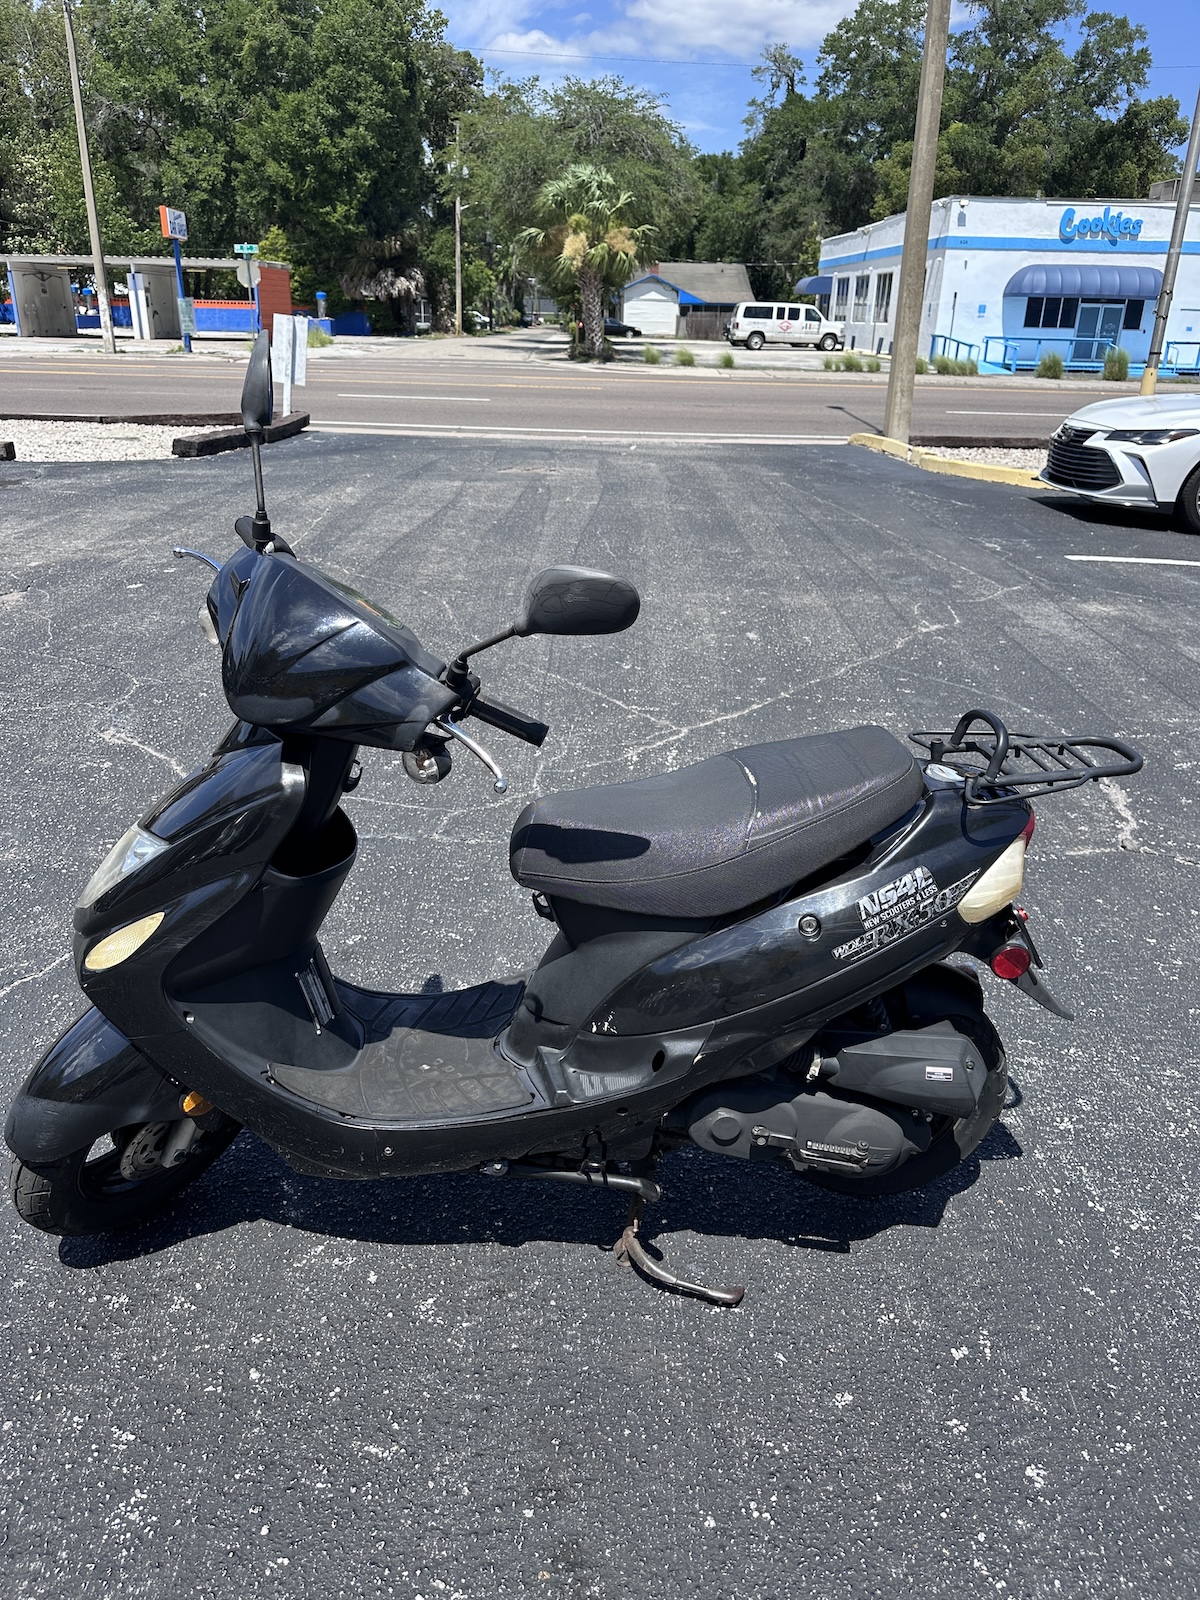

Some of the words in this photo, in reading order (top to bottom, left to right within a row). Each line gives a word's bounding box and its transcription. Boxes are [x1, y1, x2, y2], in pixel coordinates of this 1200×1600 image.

[1060, 206, 1143, 238] Cookies
[858, 867, 933, 920] NS4L
[864, 917, 881, 930] NEW
[880, 898, 916, 921] SCOOTERS
[916, 894, 921, 902] 4
[922, 884, 939, 899] LESS
